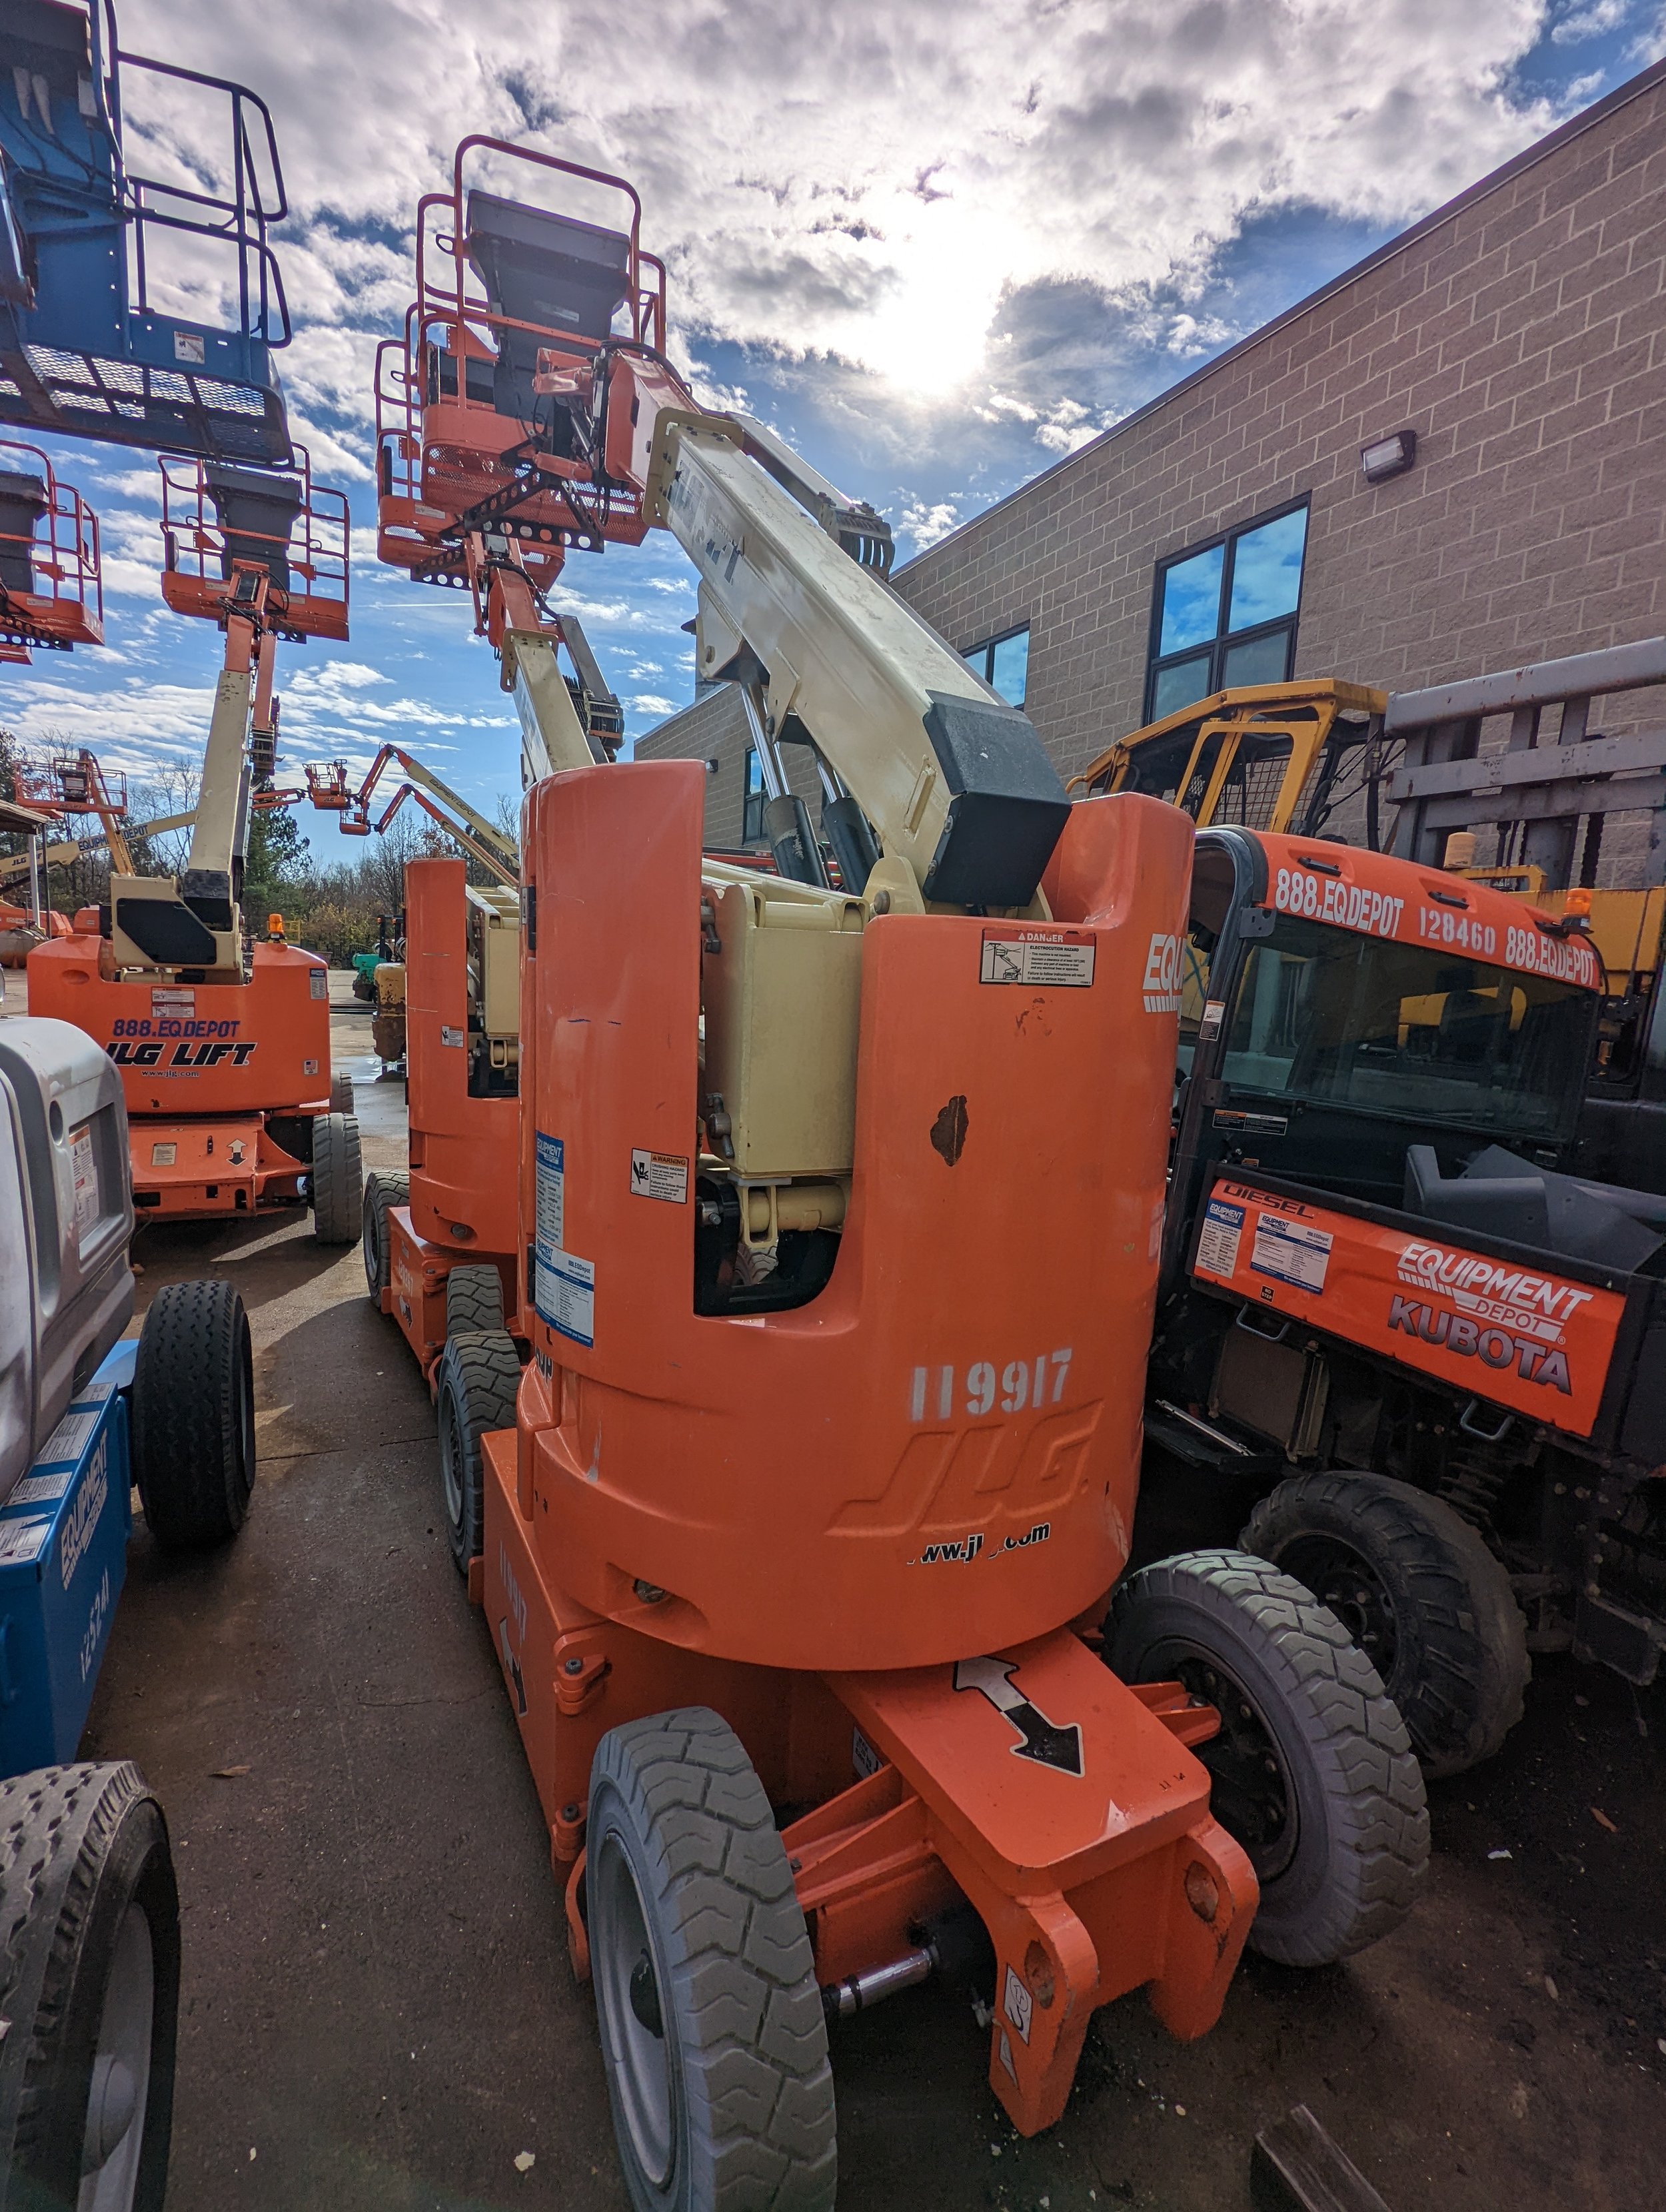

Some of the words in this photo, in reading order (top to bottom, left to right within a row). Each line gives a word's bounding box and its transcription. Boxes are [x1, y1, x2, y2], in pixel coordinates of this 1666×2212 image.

[428, 778, 458, 802] EQUIPMENT
[456, 801, 476, 818] DEPOT
[78, 835, 109, 851] EQUIPM
[123, 824, 149, 840] DEPOT
[11, 857, 27, 866] JLG
[1275, 867, 1404, 939] 888.EQDEPOT
[1027, 933, 1064, 943] DANGER
[1419, 906, 1497, 955] 128460
[1505, 925, 1595, 986] 888.EQDEPOT
[113, 1019, 241, 1038] 888.EQDEPOT
[169, 1041, 258, 1067] LIFT
[141, 1069, 200, 1078] www.jlg.com
[1210, 1203, 1243, 1219] EQUIPMENT
[1224, 1183, 1314, 1219] DIESEL
[1261, 1215, 1289, 1229] EQUIPMENT
[1398, 1241, 1593, 1320] EQUIPMENT
[1473, 1298, 1541, 1333] DEPOT
[1387, 1295, 1573, 1397] KUBOTA
[910, 1347, 1073, 1422] 119917
[824, 1398, 1105, 1536] JLG
[61, 1428, 108, 1582] EQUIPMENT
[907, 1522, 1051, 1565] ww.jl.com
